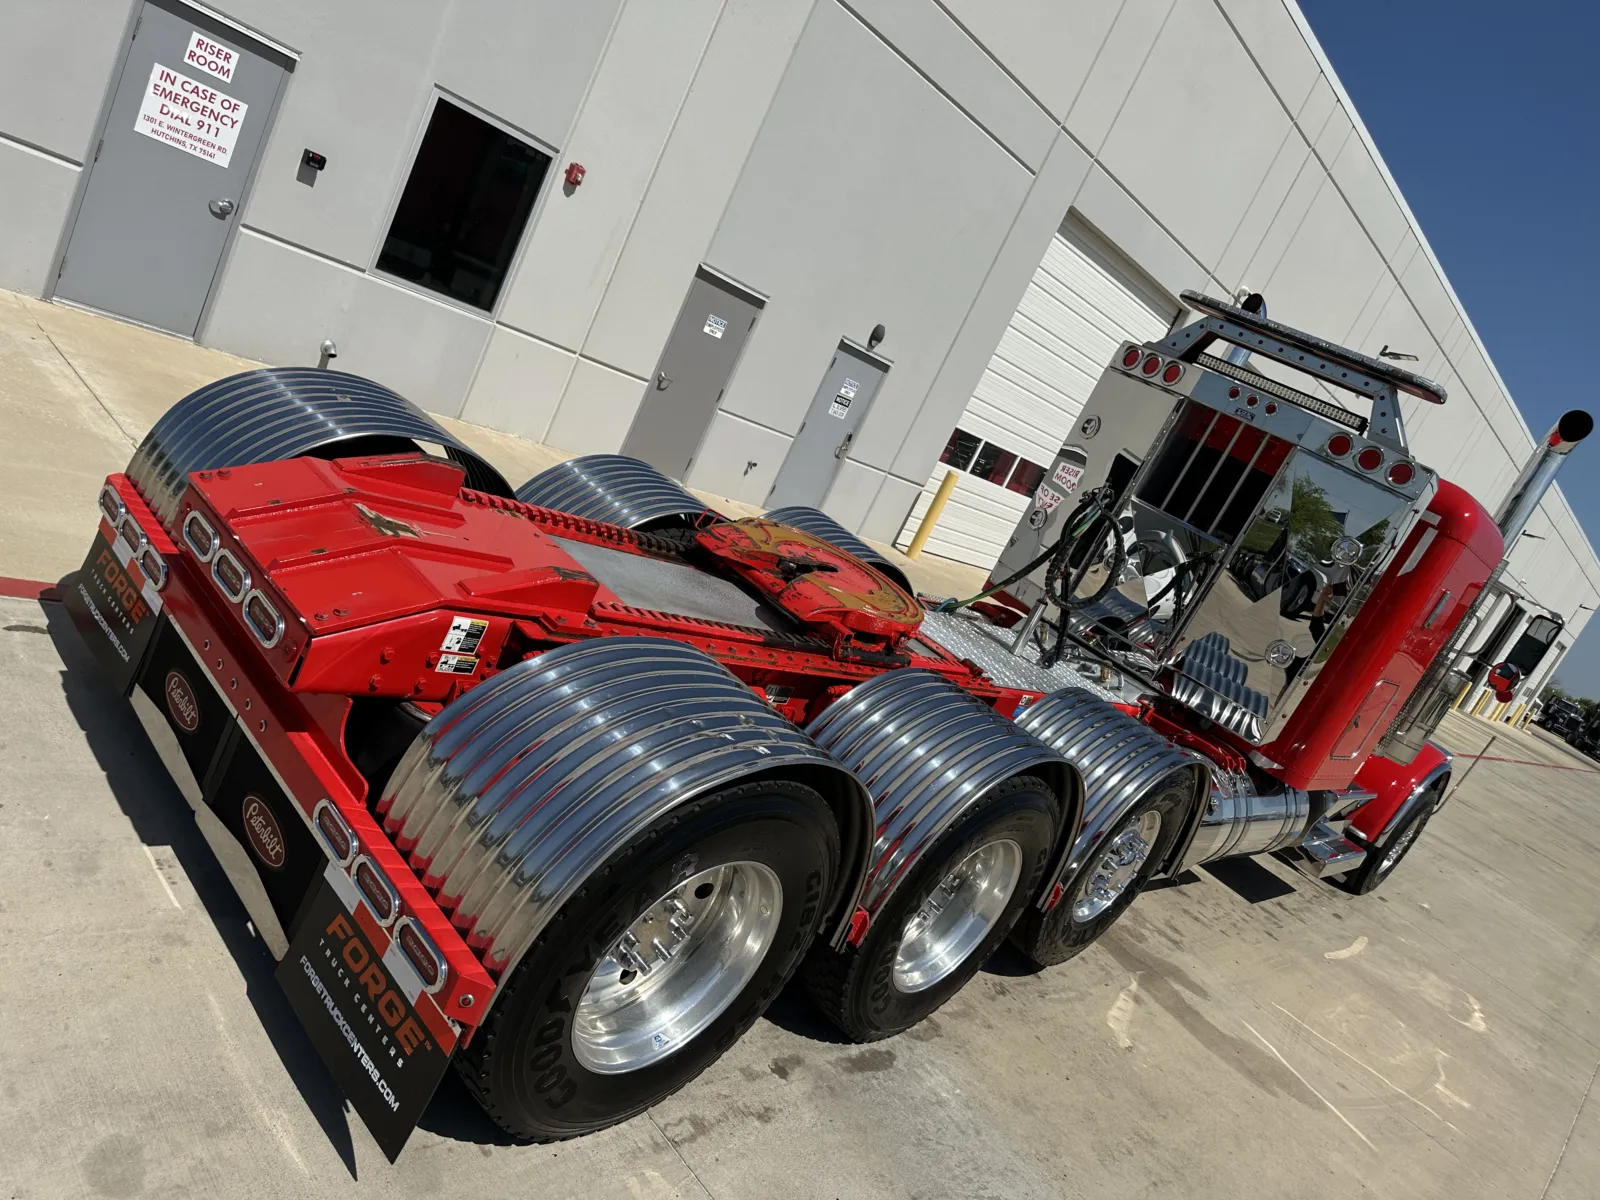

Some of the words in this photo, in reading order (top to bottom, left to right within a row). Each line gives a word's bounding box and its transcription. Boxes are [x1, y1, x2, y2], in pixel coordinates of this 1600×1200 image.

[187, 50, 231, 79] ROOM
[195, 38, 232, 64] RISER
[152, 83, 239, 129] EMERGENCY
[159, 70, 177, 86] IN
[181, 80, 217, 104] CASE
[220, 99, 240, 114] OF
[143, 114, 157, 125] 1301
[166, 123, 216, 150] WINTERGREEN
[217, 145, 228, 155] RD.
[151, 128, 188, 148] HUTCHINS,
[189, 144, 198, 152] TX
[199, 147, 216, 160] 75141
[197, 120, 220, 138] 911
[97, 549, 146, 624] FORGE
[107, 595, 135, 635] CENTERS
[168, 676, 197, 724] Peterbilt
[246, 802, 283, 860] Peterbilt
[319, 938, 351, 988] TRUCK
[354, 993, 404, 1068] CENTERS
[326, 913, 426, 1056] FORGE
[299, 954, 400, 1113] FORGETRUCKCENTERS.COM
